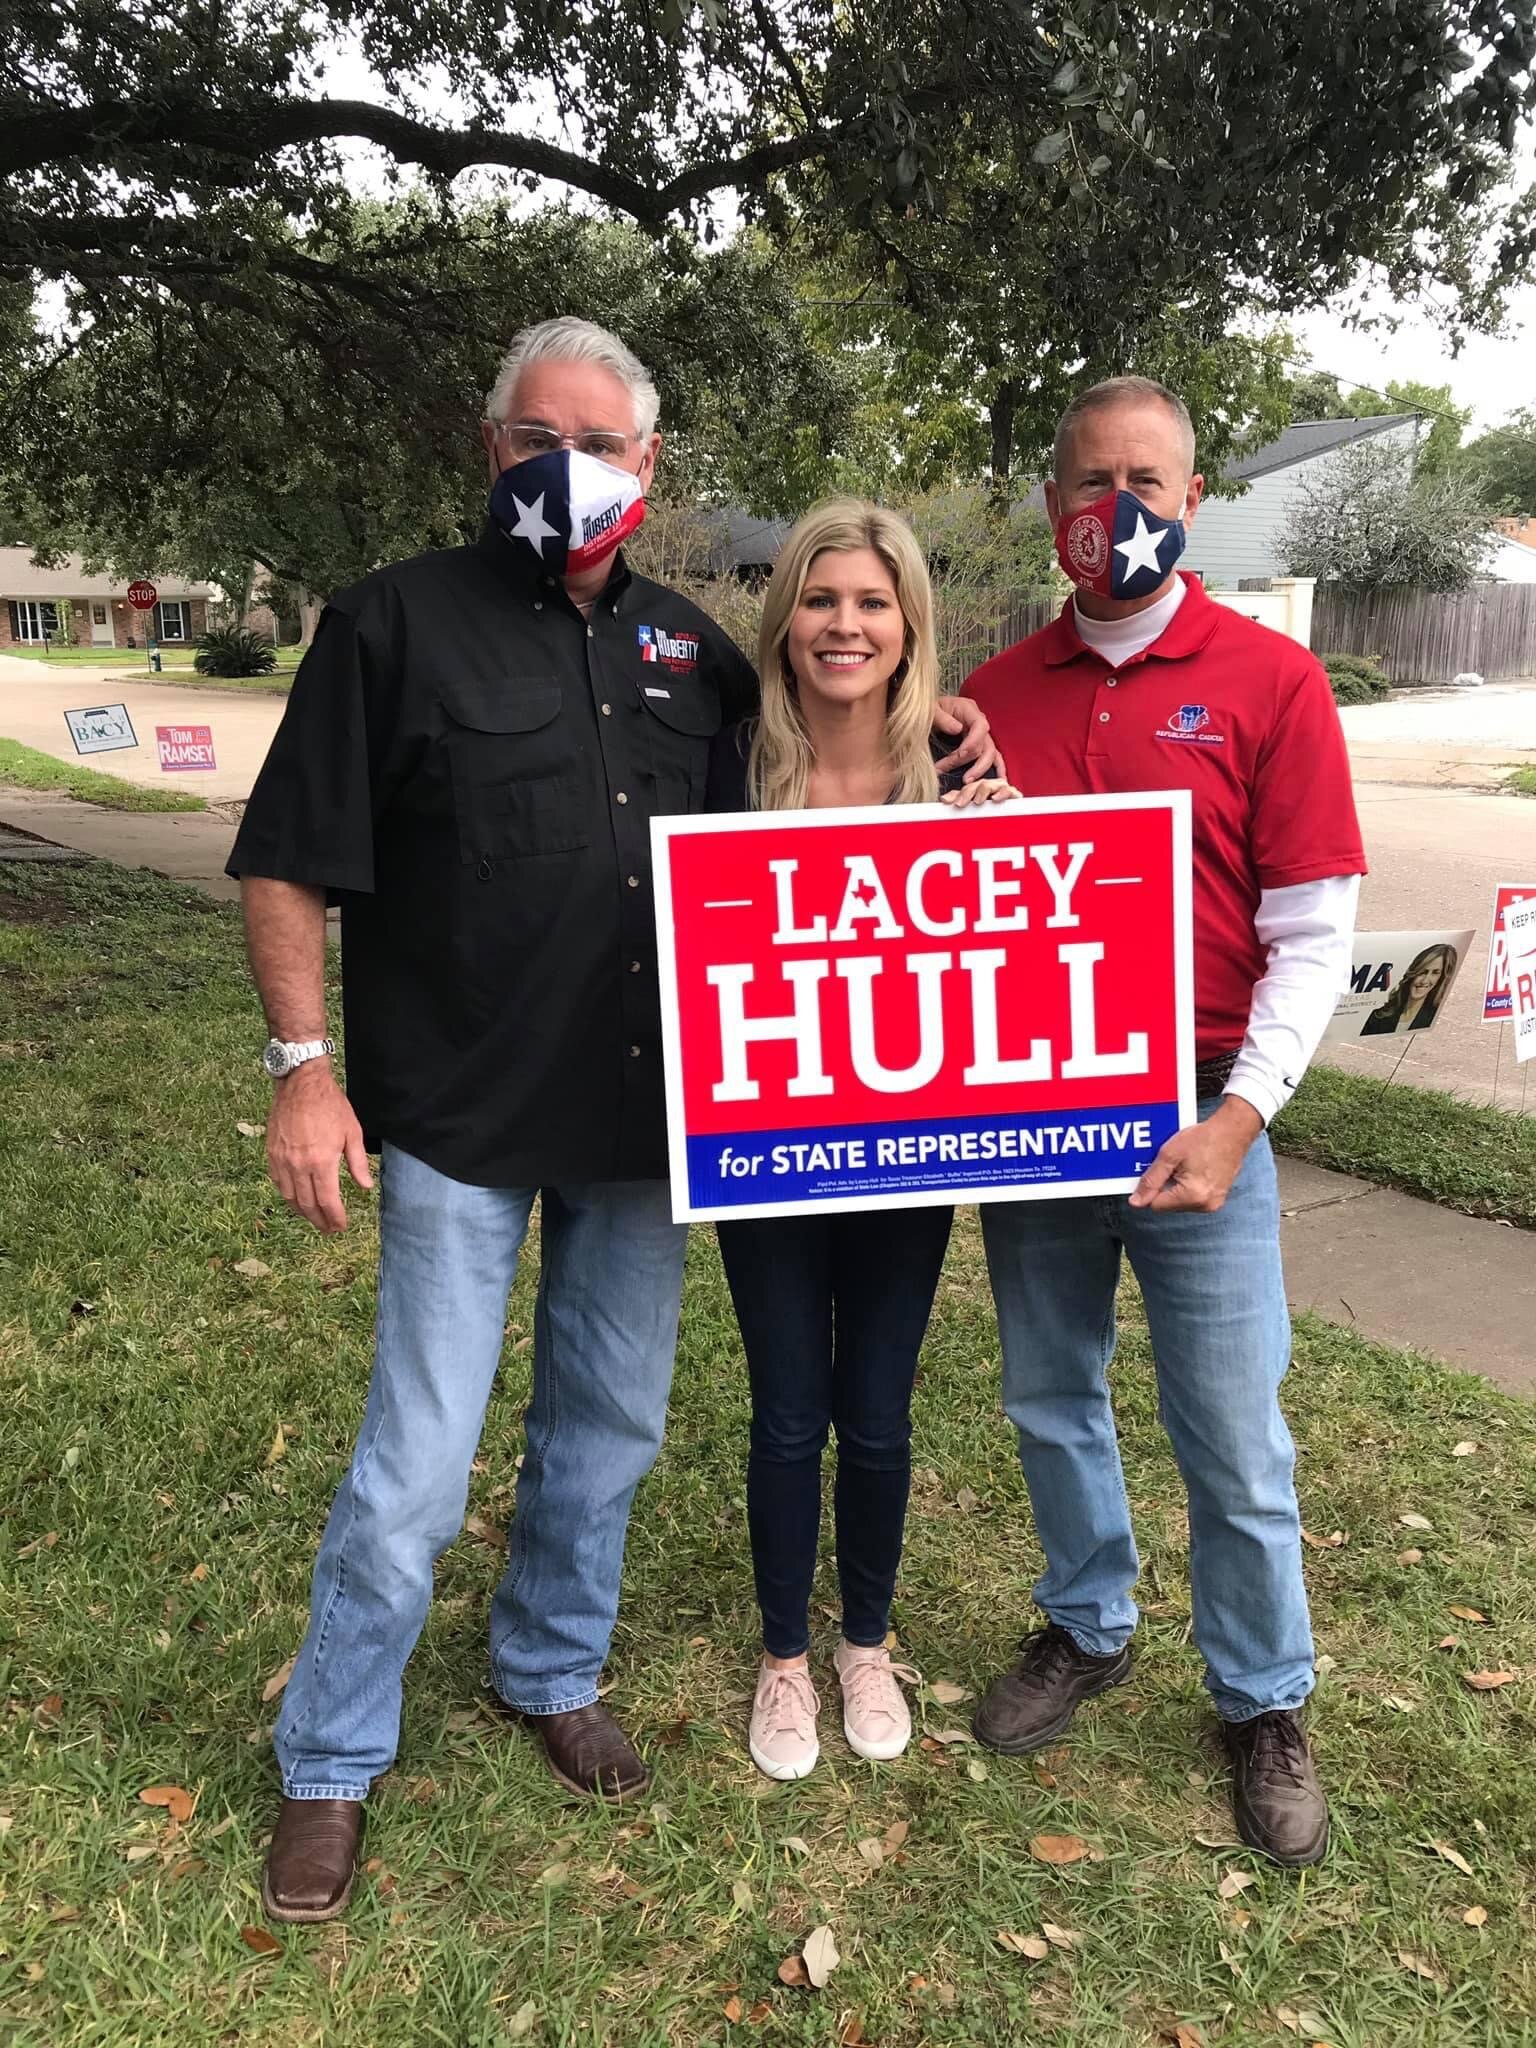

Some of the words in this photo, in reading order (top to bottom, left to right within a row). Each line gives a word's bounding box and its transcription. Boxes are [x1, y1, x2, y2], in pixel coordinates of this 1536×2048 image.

[583, 499, 622, 545] HUBERTY
[129, 590, 155, 602] STOP
[657, 638, 699, 661] HUBERTY
[75, 722, 124, 740] BACY
[166, 728, 193, 745] TOM
[158, 741, 213, 764] RAMSEY
[769, 842, 1094, 945] LACEY
[706, 942, 1149, 1102] HULL
[718, 1147, 765, 1178] for
[771, 1141, 866, 1174] STATE
[877, 1120, 1152, 1166] REPRESENTATIVE
